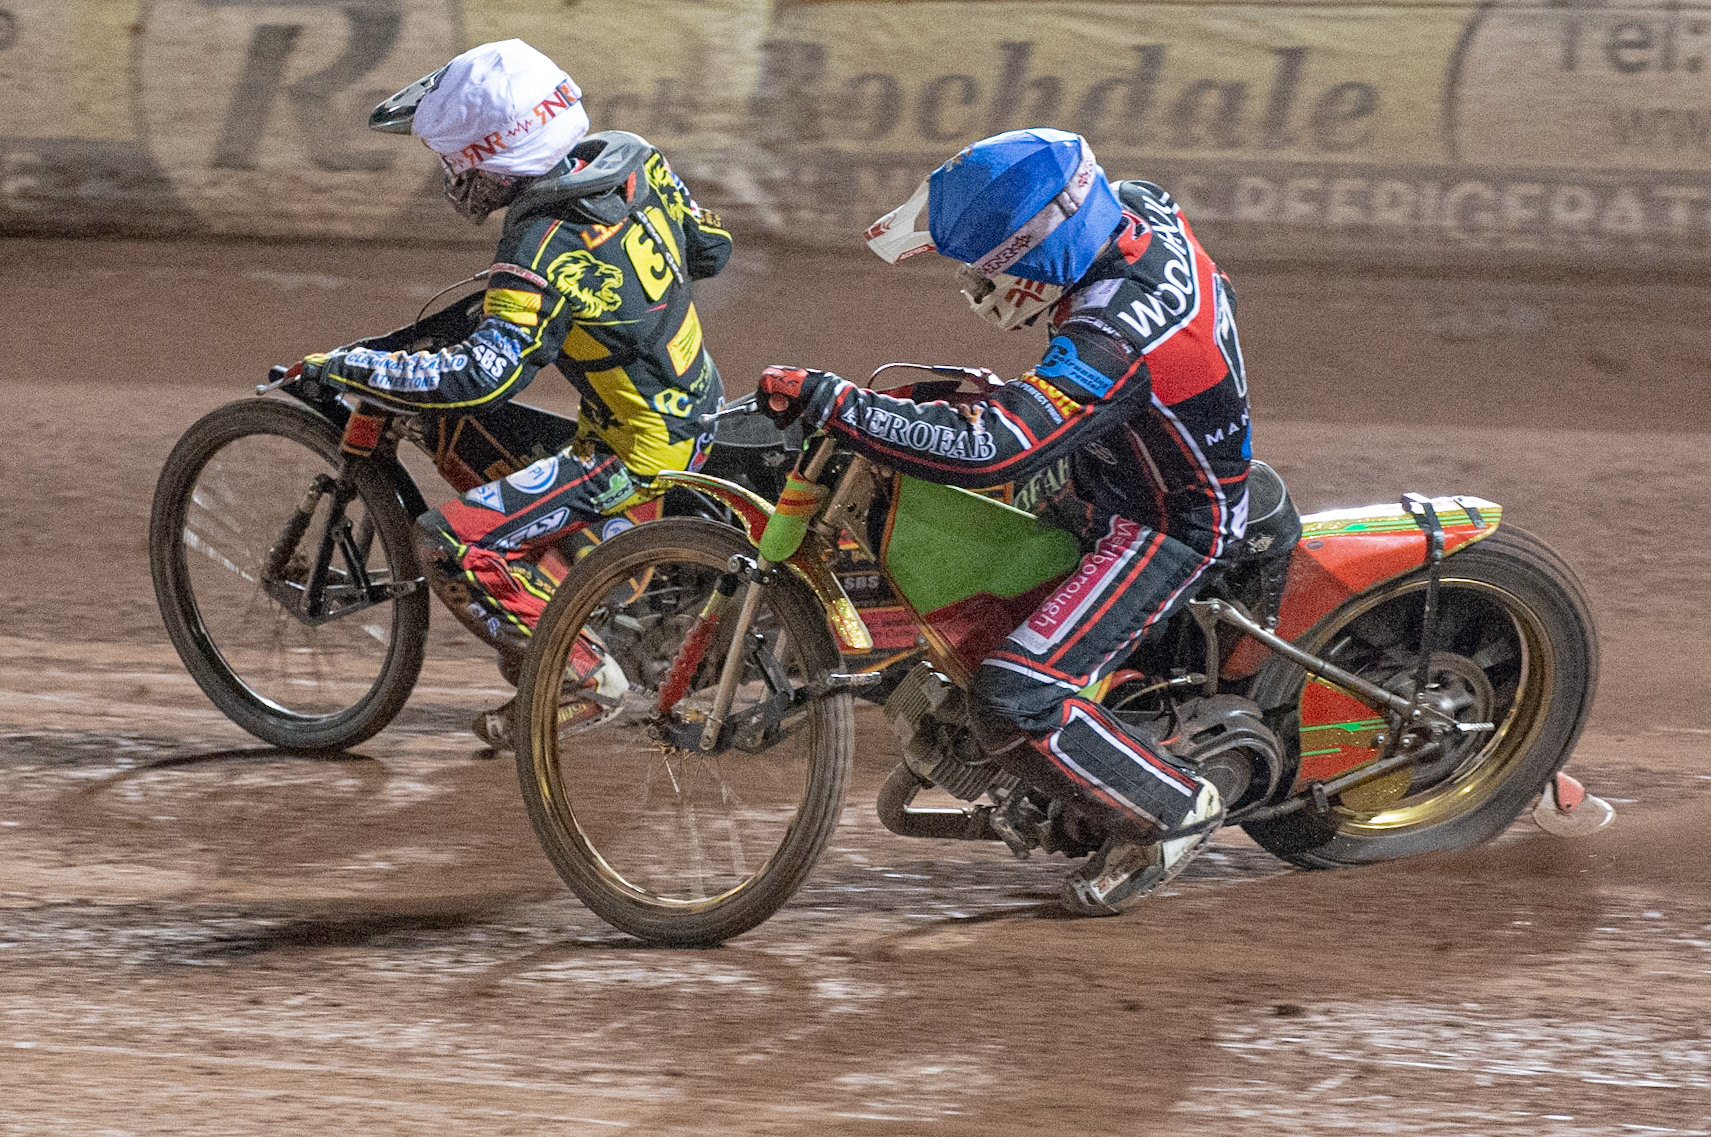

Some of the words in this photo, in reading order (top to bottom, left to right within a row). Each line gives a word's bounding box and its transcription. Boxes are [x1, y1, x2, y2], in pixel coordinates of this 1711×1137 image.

[472, 344, 508, 378] SBS
[841, 397, 997, 463] AEROFAB
[1023, 515, 1139, 629] Marlborough
